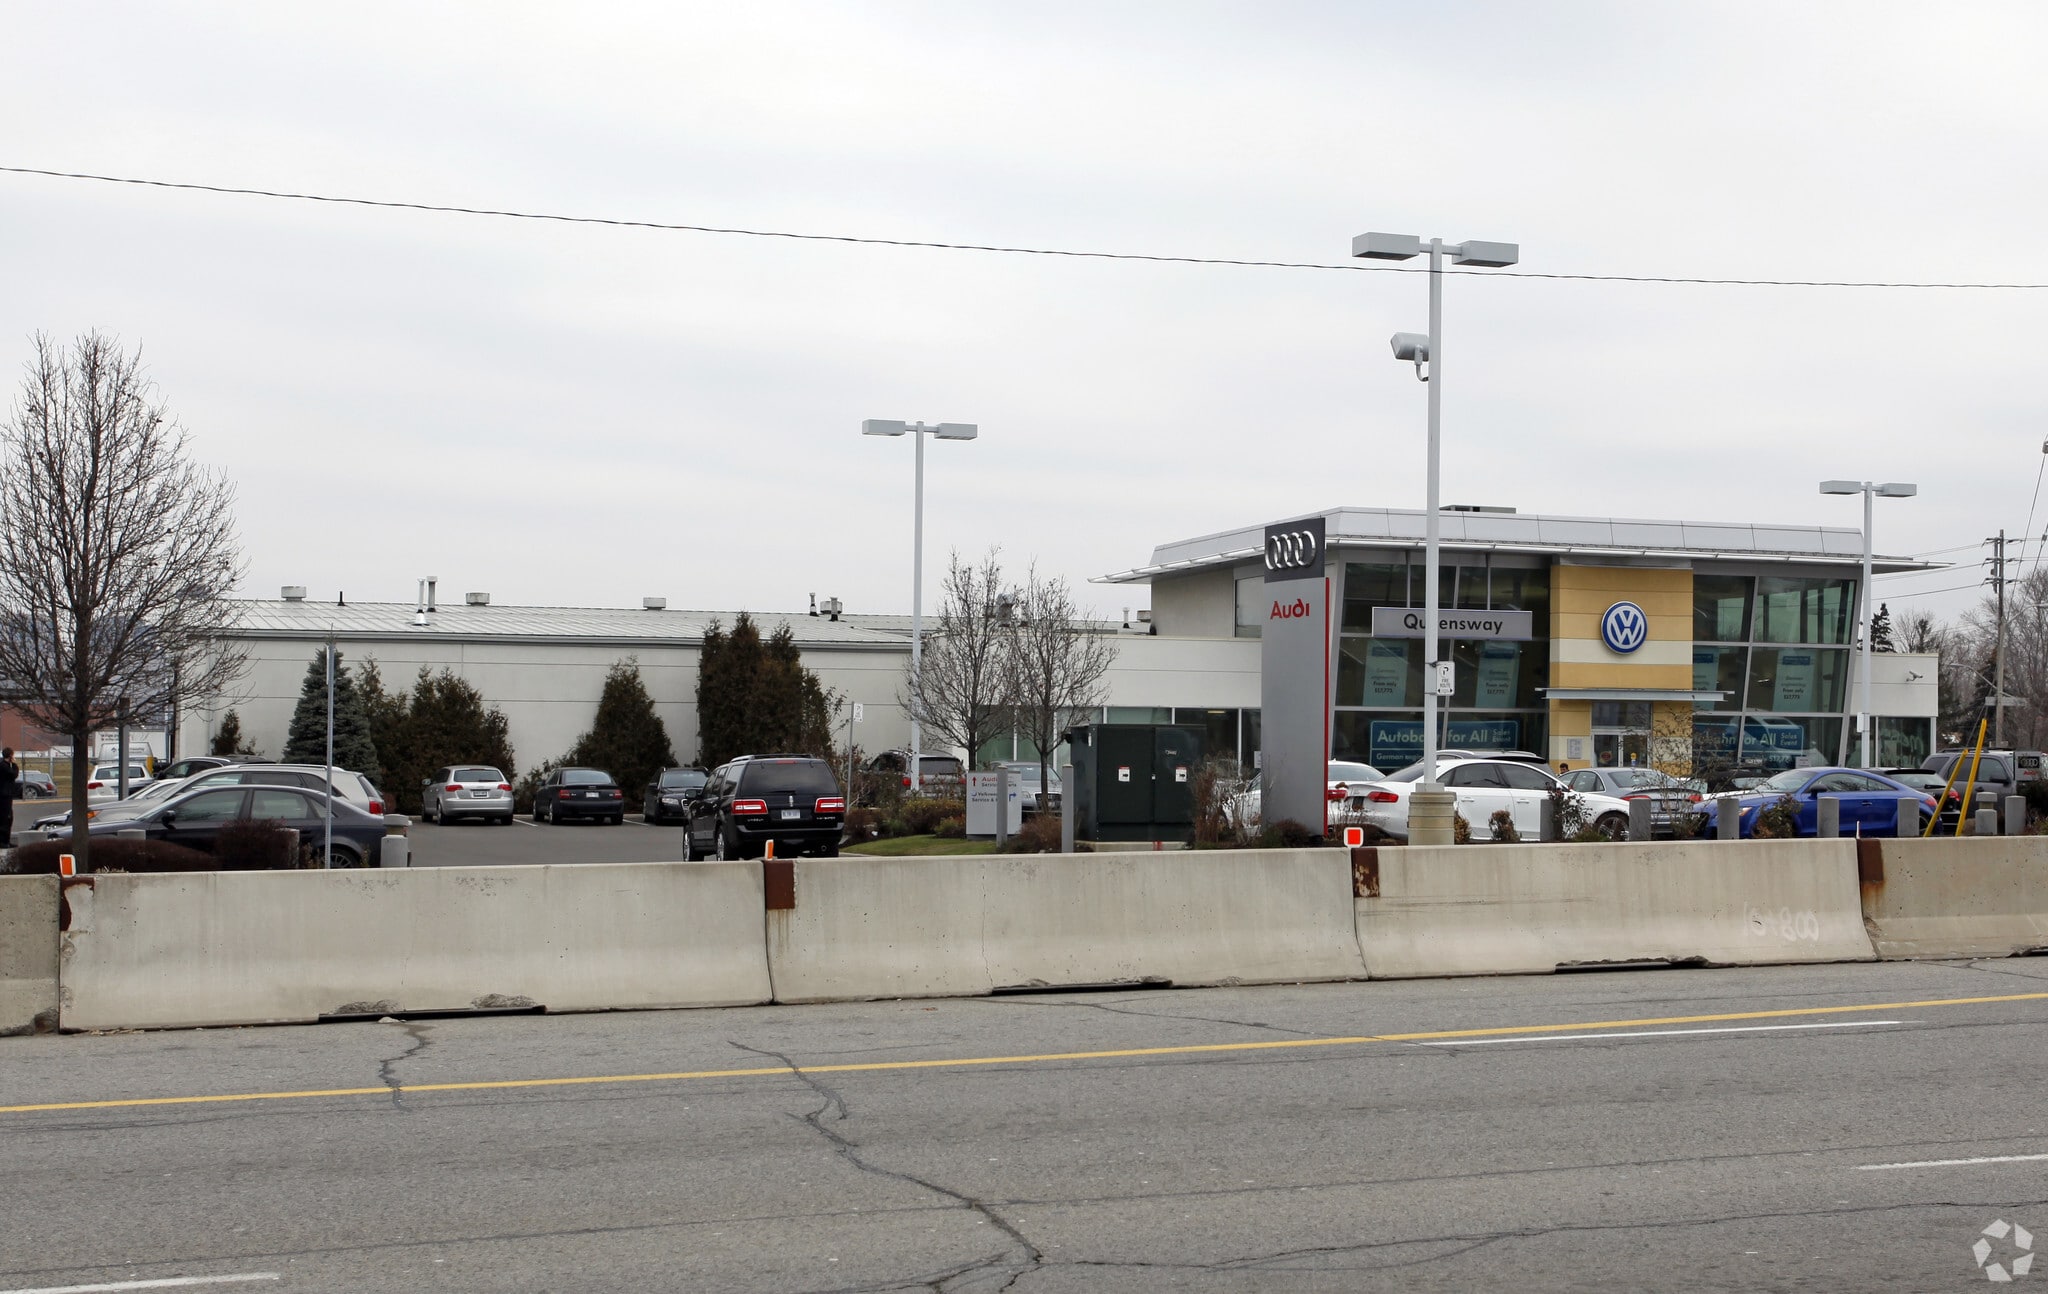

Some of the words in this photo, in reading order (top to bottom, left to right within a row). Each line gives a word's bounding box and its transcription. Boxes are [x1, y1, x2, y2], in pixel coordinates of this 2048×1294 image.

[1270, 598, 1310, 620] Audi
[1403, 613, 1503, 635] Quensway
[1447, 729, 1466, 743] for
[1469, 729, 1488, 743] All
[1760, 732, 1777, 746] All
[1780, 739, 1798, 747] Event
[1376, 753, 1404, 761] German
